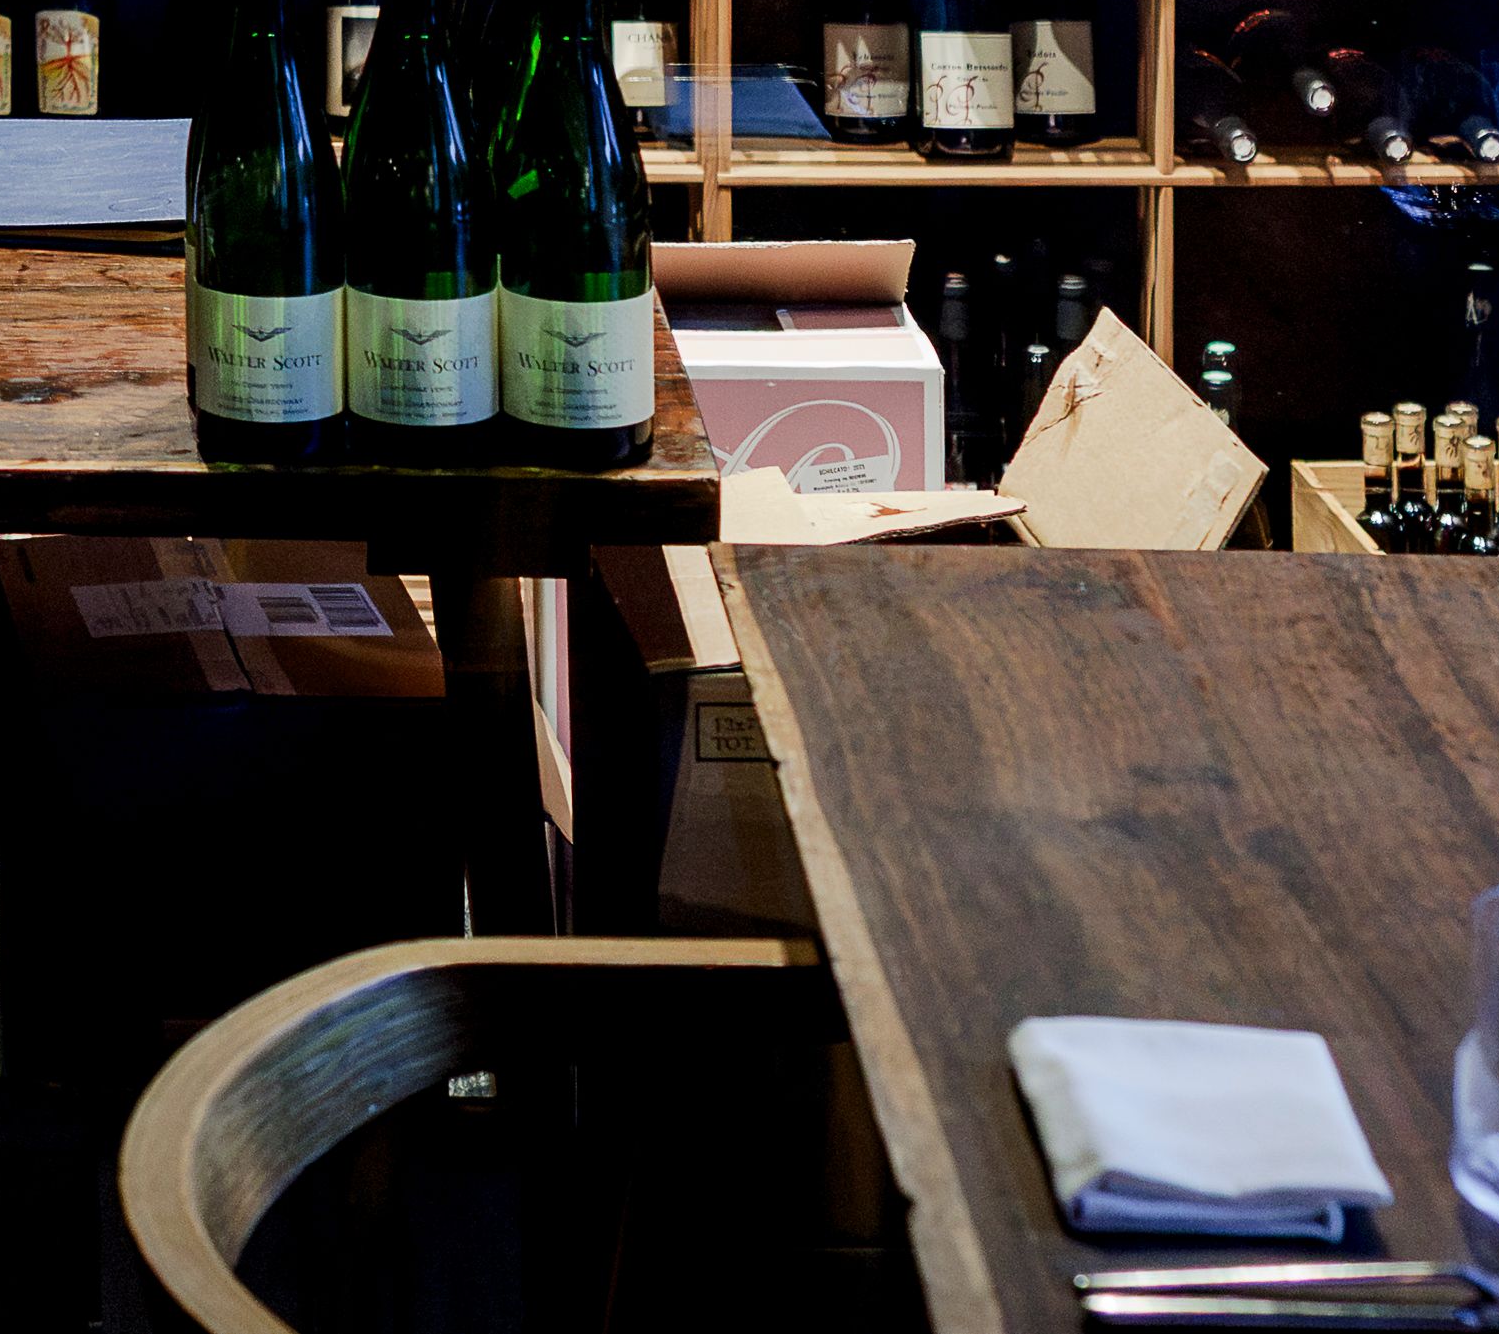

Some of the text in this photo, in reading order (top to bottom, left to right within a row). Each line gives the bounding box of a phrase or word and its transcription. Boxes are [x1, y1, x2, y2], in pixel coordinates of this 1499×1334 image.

[207, 345, 323, 372] WALTER SCOTT
[363, 349, 480, 375] WALTER SCOTT
[517, 350, 637, 377] WALTER SCOTT
